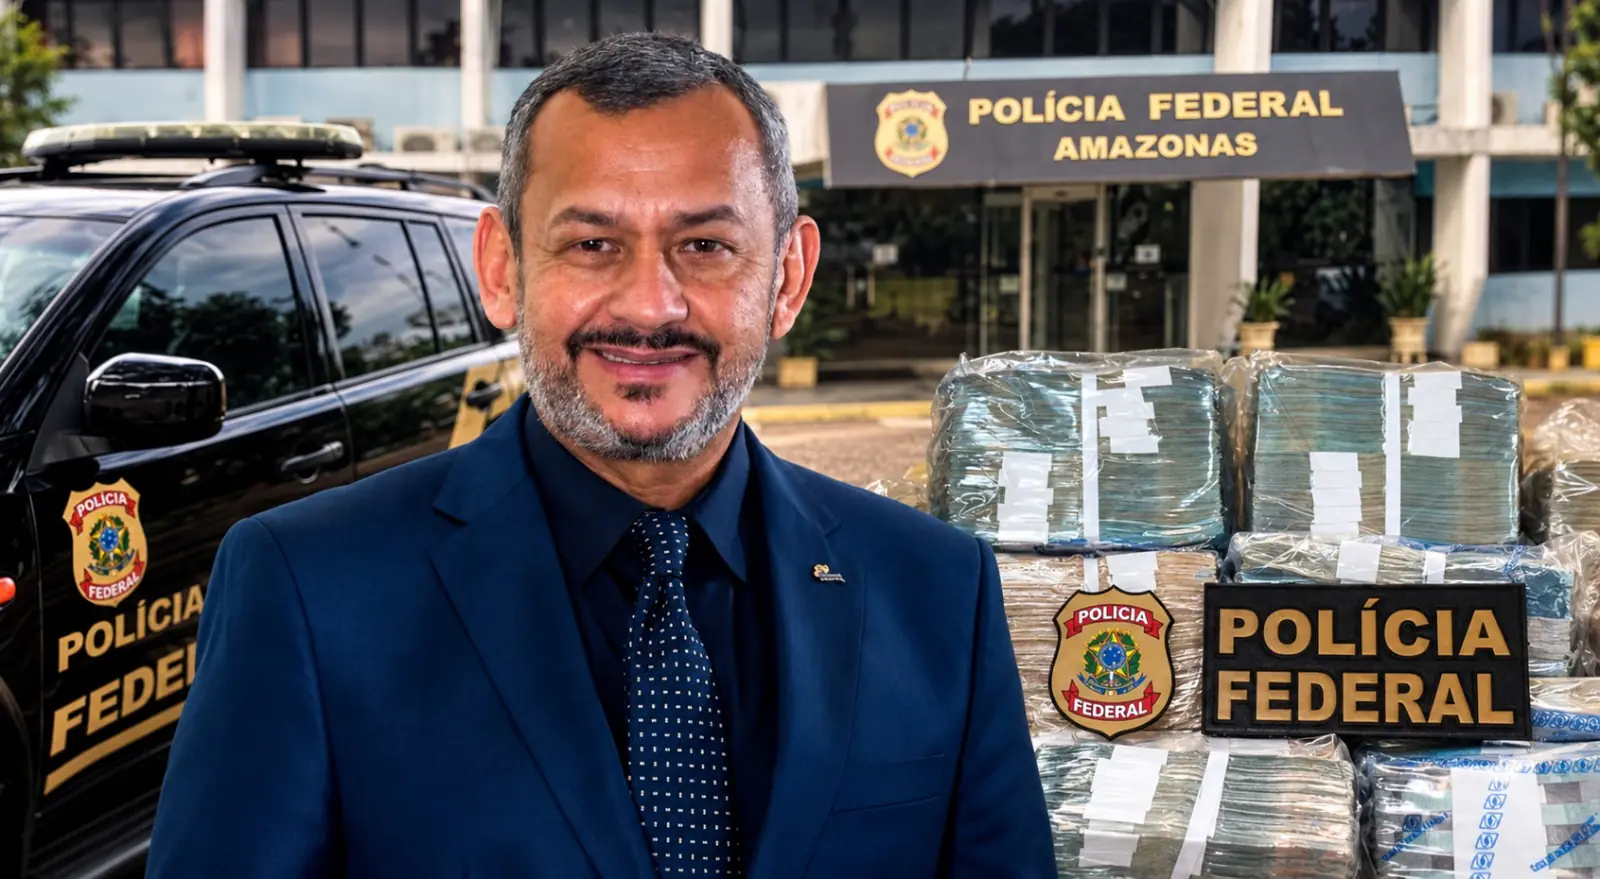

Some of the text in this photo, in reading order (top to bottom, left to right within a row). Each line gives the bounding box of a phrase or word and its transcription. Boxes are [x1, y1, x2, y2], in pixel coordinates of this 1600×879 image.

[968, 90, 1345, 125] POLÍCIA FEDERAL
[1053, 132, 1258, 161] AMAZONAS
[88, 572, 140, 599] FEDERAL
[58, 588, 204, 673] POLÍCIA
[1218, 597, 1511, 657] POLÍCIA
[1073, 698, 1148, 719] FEDERAL
[1216, 670, 1515, 725] FEDERAL
